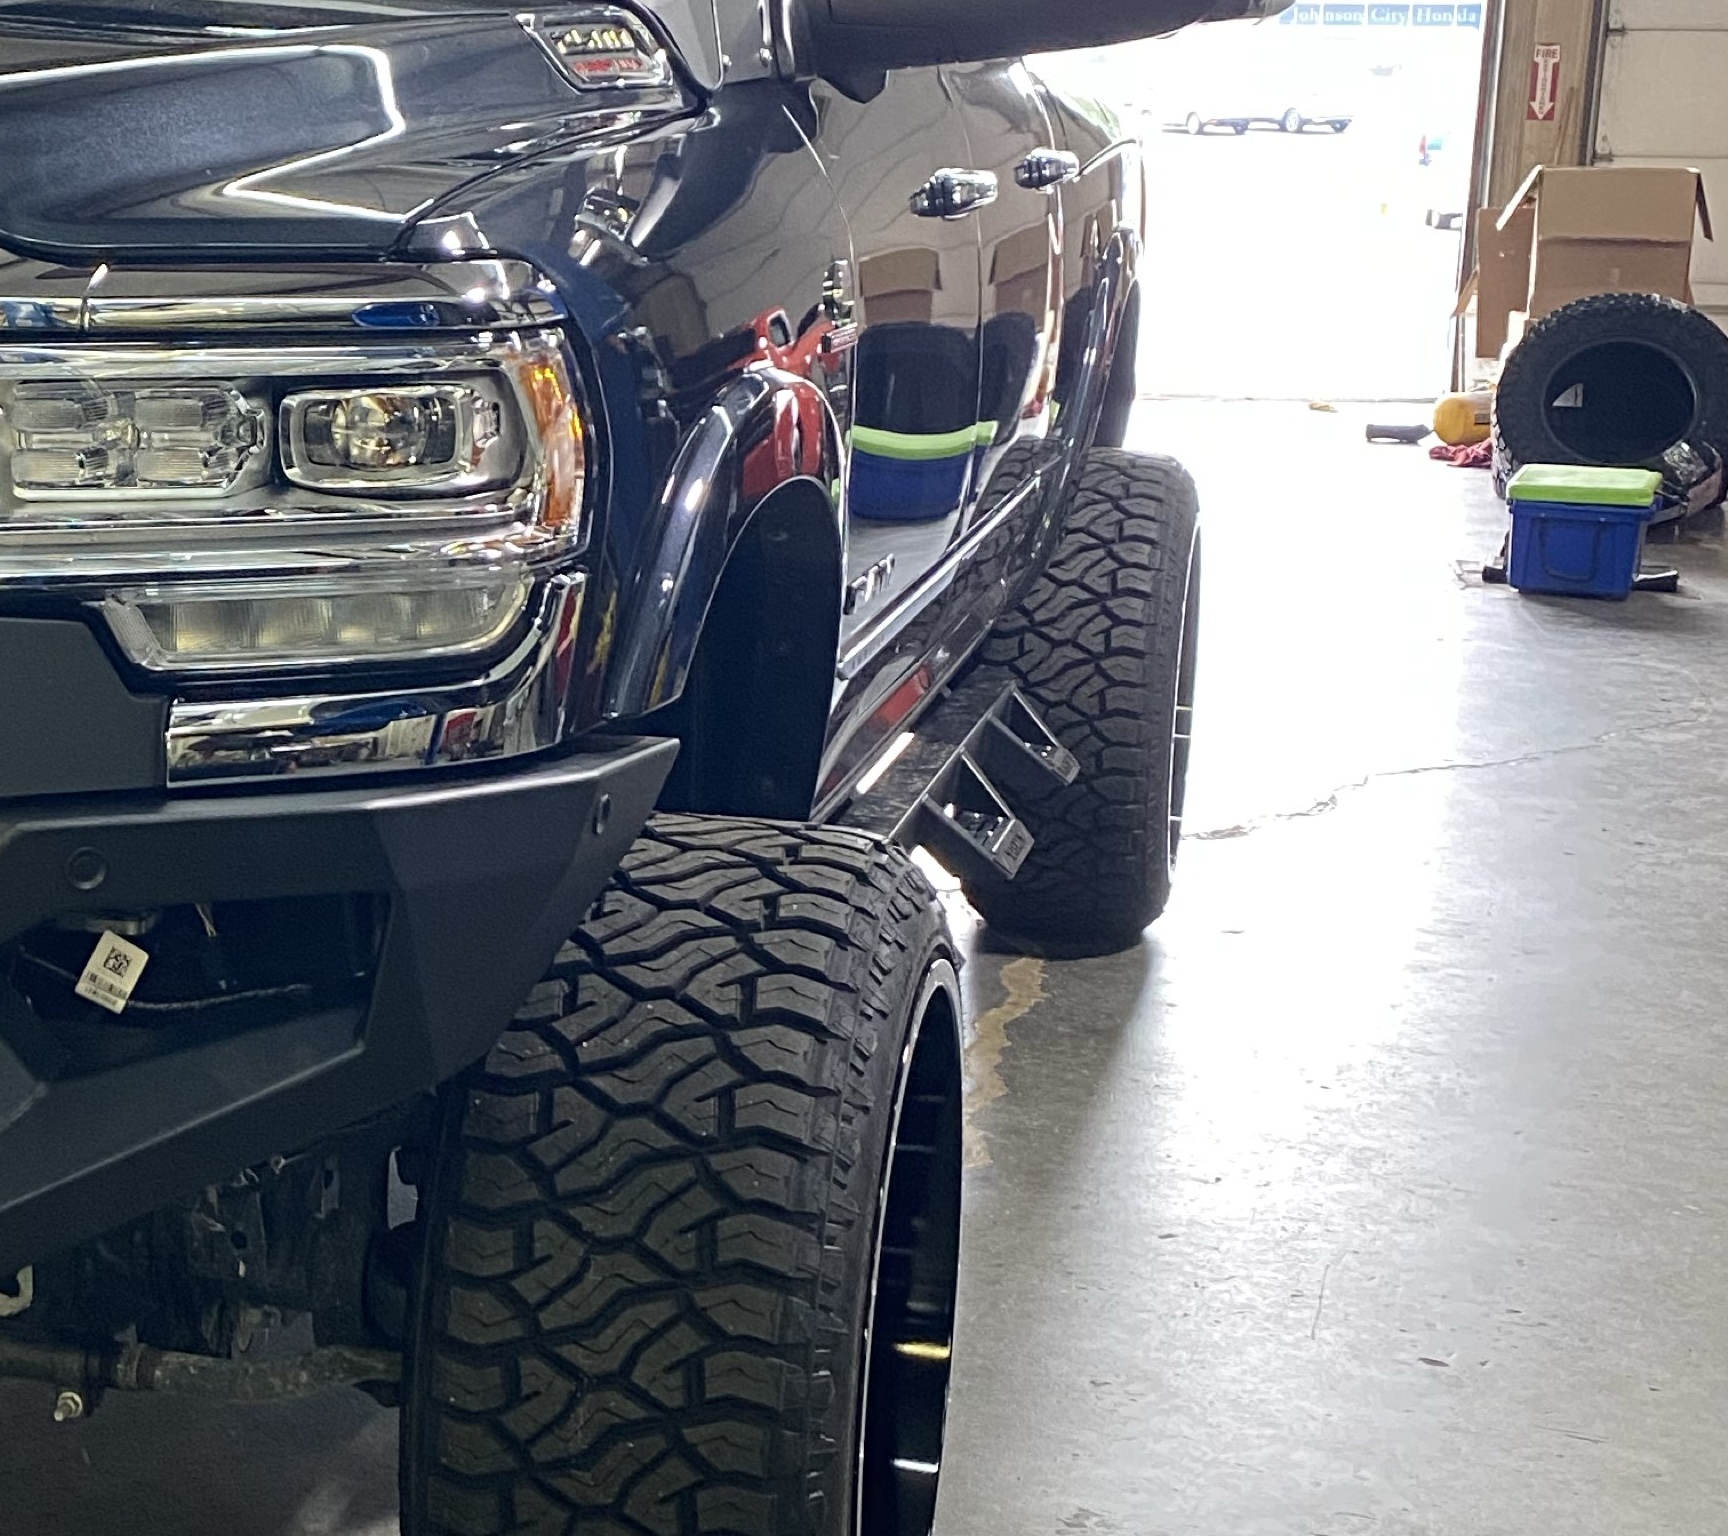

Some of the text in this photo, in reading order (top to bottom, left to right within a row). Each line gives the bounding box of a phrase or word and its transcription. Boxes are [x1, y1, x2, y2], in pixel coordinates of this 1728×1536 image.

[1290, 7, 1476, 26] Johnson City Honda
[1536, 48, 1559, 59] FIRE
